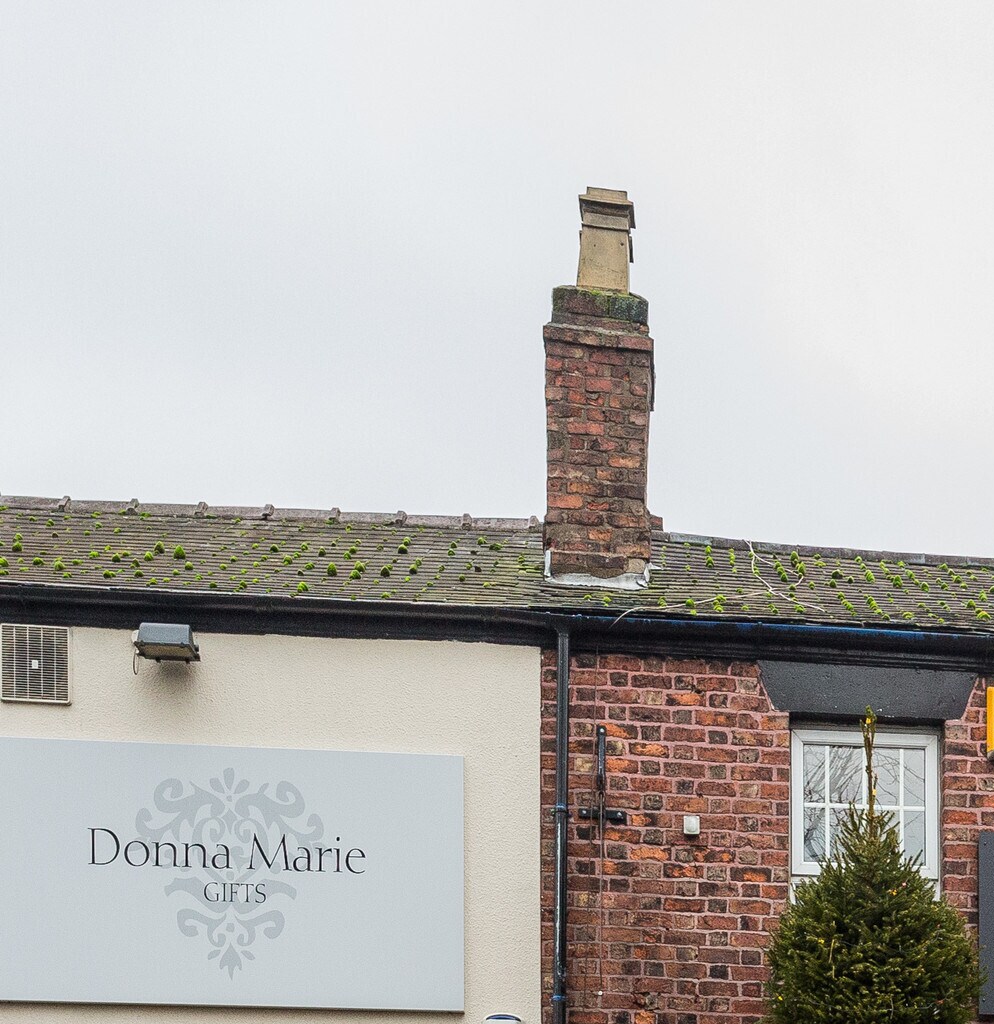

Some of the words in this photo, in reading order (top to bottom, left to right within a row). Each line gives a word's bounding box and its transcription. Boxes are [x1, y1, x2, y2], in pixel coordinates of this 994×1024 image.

[87, 826, 232, 871] Donna
[246, 832, 367, 875] Marie
[203, 881, 267, 904] GIFTS
